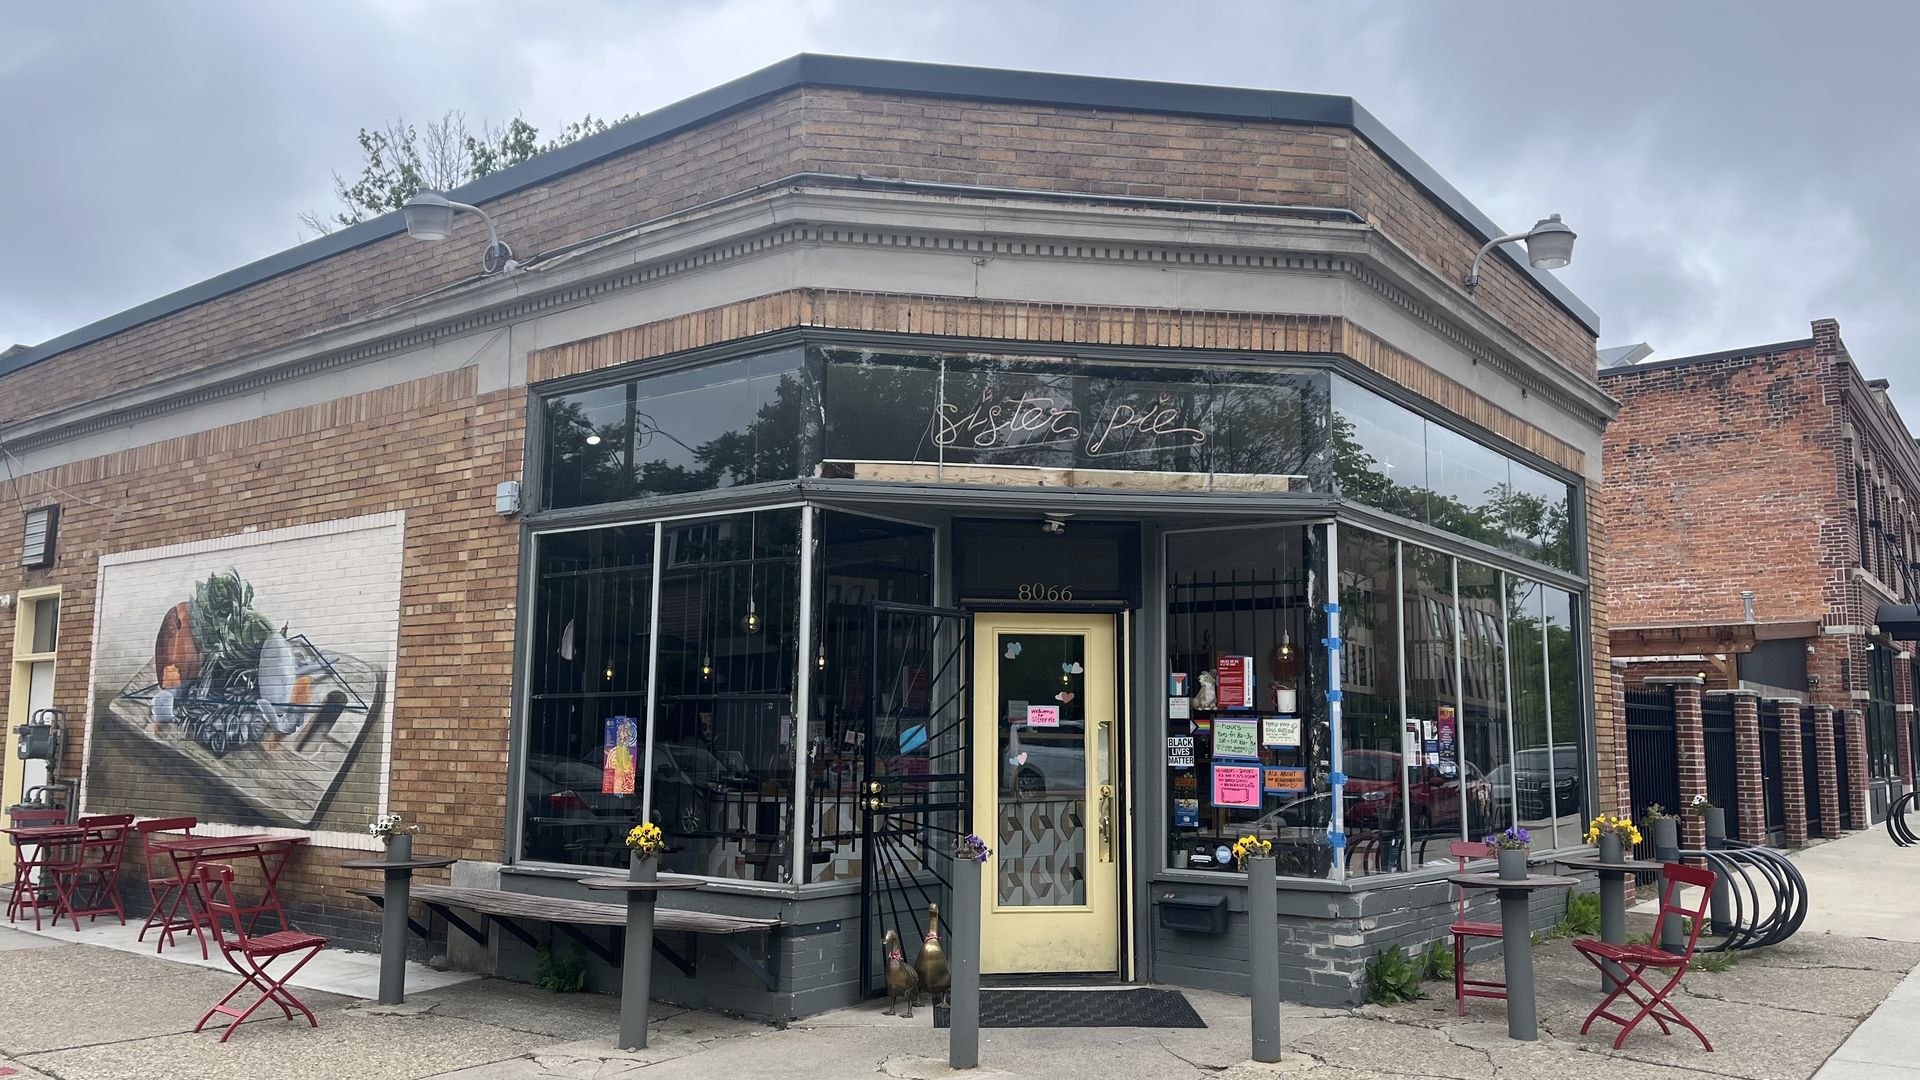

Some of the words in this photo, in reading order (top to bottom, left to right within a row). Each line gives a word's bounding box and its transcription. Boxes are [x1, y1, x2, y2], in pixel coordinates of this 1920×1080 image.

[1091, 391, 1207, 453] pie
[1018, 582, 1073, 602] 8066
[1221, 722, 1242, 731] hours
[1168, 738, 1193, 747] BLACK
[1171, 747, 1190, 756] LIVES
[1168, 756, 1195, 765] MATTER
